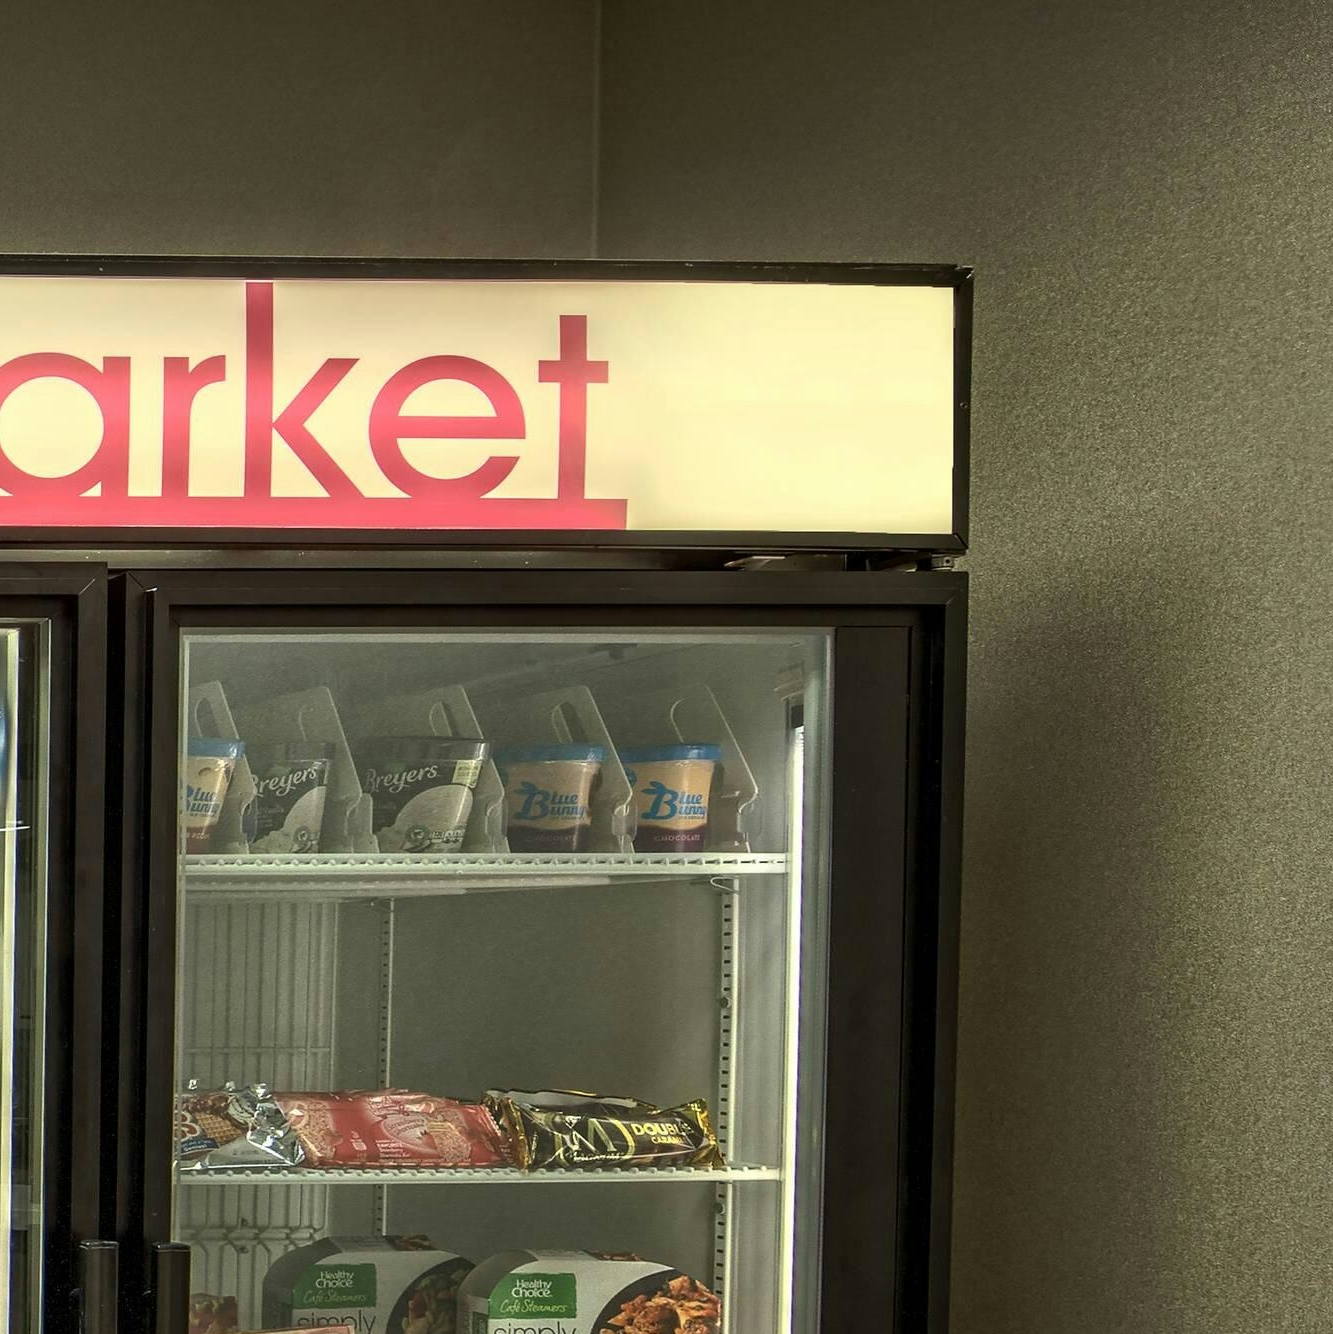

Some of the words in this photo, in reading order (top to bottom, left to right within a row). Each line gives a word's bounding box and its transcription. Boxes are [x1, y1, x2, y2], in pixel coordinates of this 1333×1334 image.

[365, 765, 439, 794] Breyers
[632, 1123, 694, 1136] DOUBLE
[321, 1271, 354, 1281] Healthy
[316, 1279, 353, 1288] Choice
[516, 1279, 552, 1289] Healthy
[512, 1288, 552, 1297] Choice
[500, 1299, 521, 1314] Café
[522, 1298, 567, 1313] Steamers
